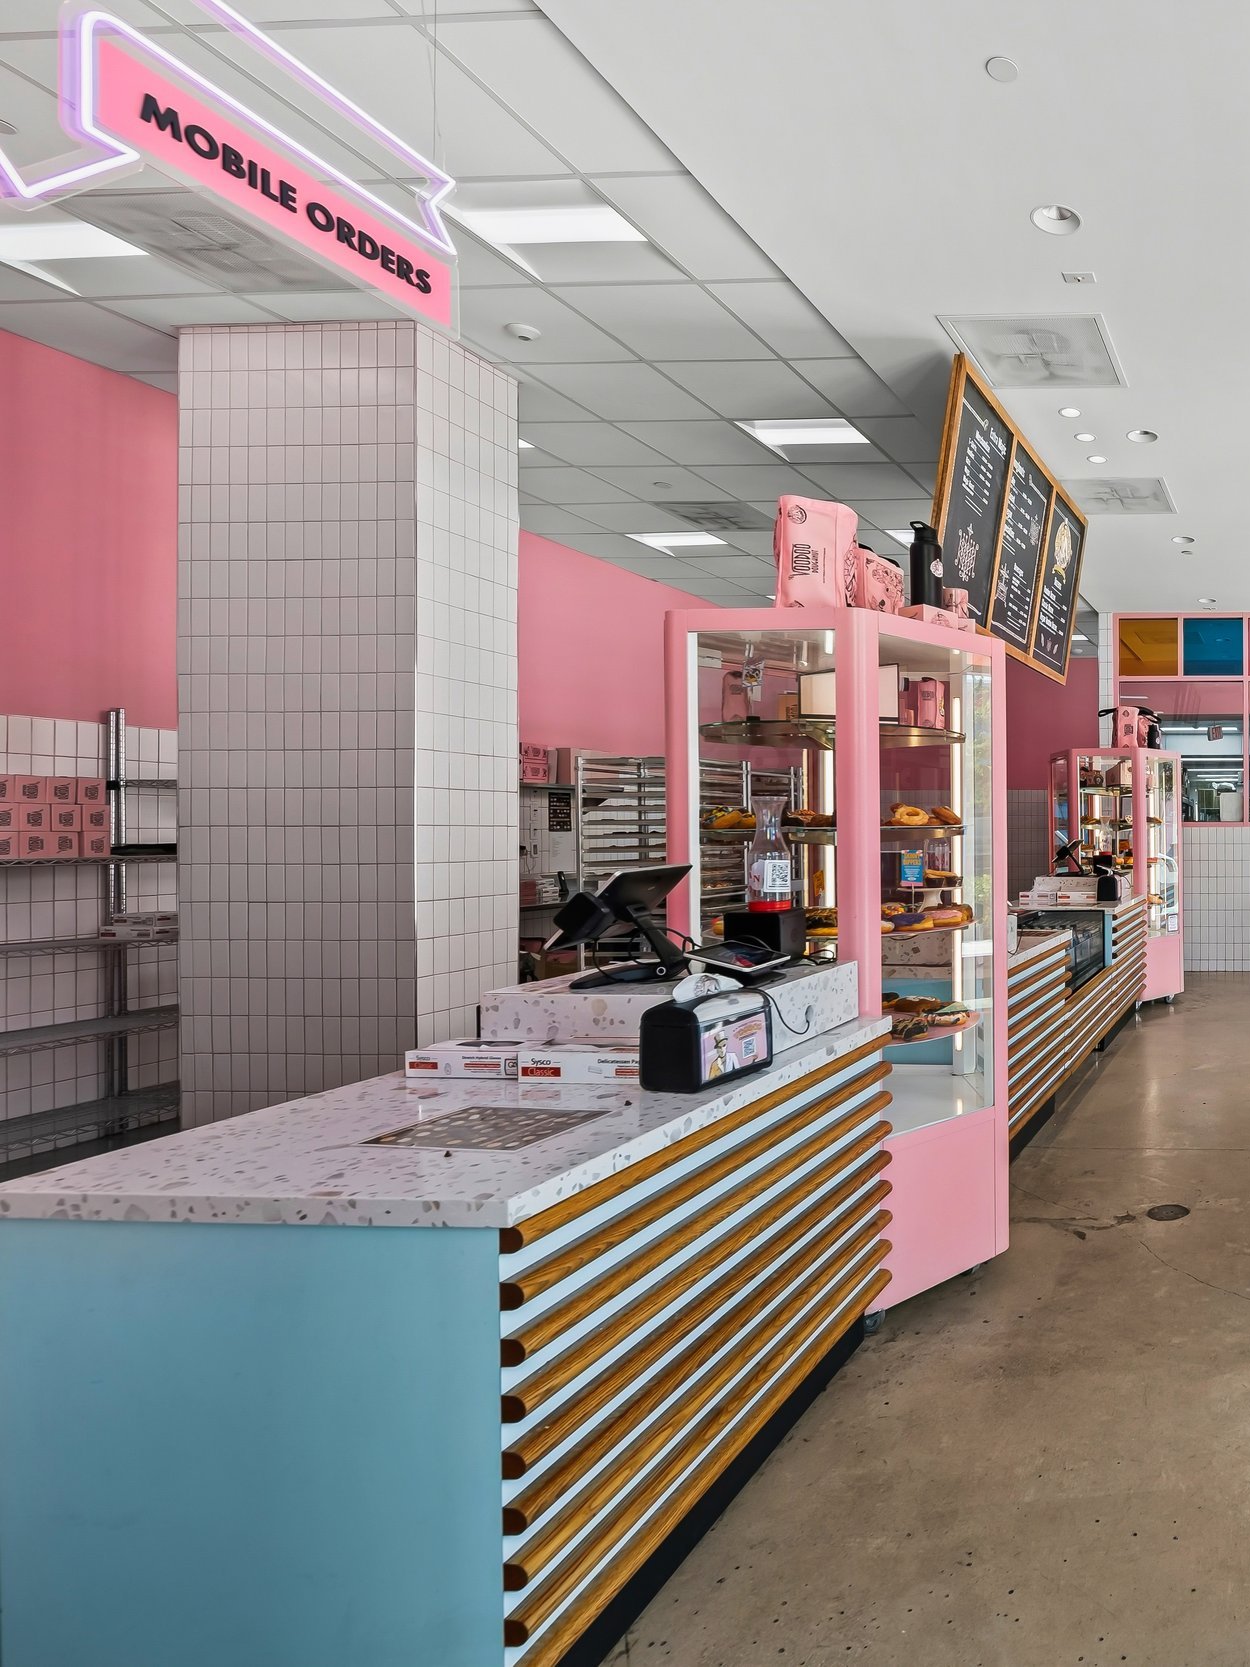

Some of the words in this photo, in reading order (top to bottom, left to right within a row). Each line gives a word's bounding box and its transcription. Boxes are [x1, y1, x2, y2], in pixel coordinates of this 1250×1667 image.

[140, 92, 298, 214] MOBILE
[306, 201, 432, 295] ORDERS
[791, 544, 811, 576] VOODOO
[527, 1068, 554, 1076] Classic
[530, 1058, 551, 1066] Sysco
